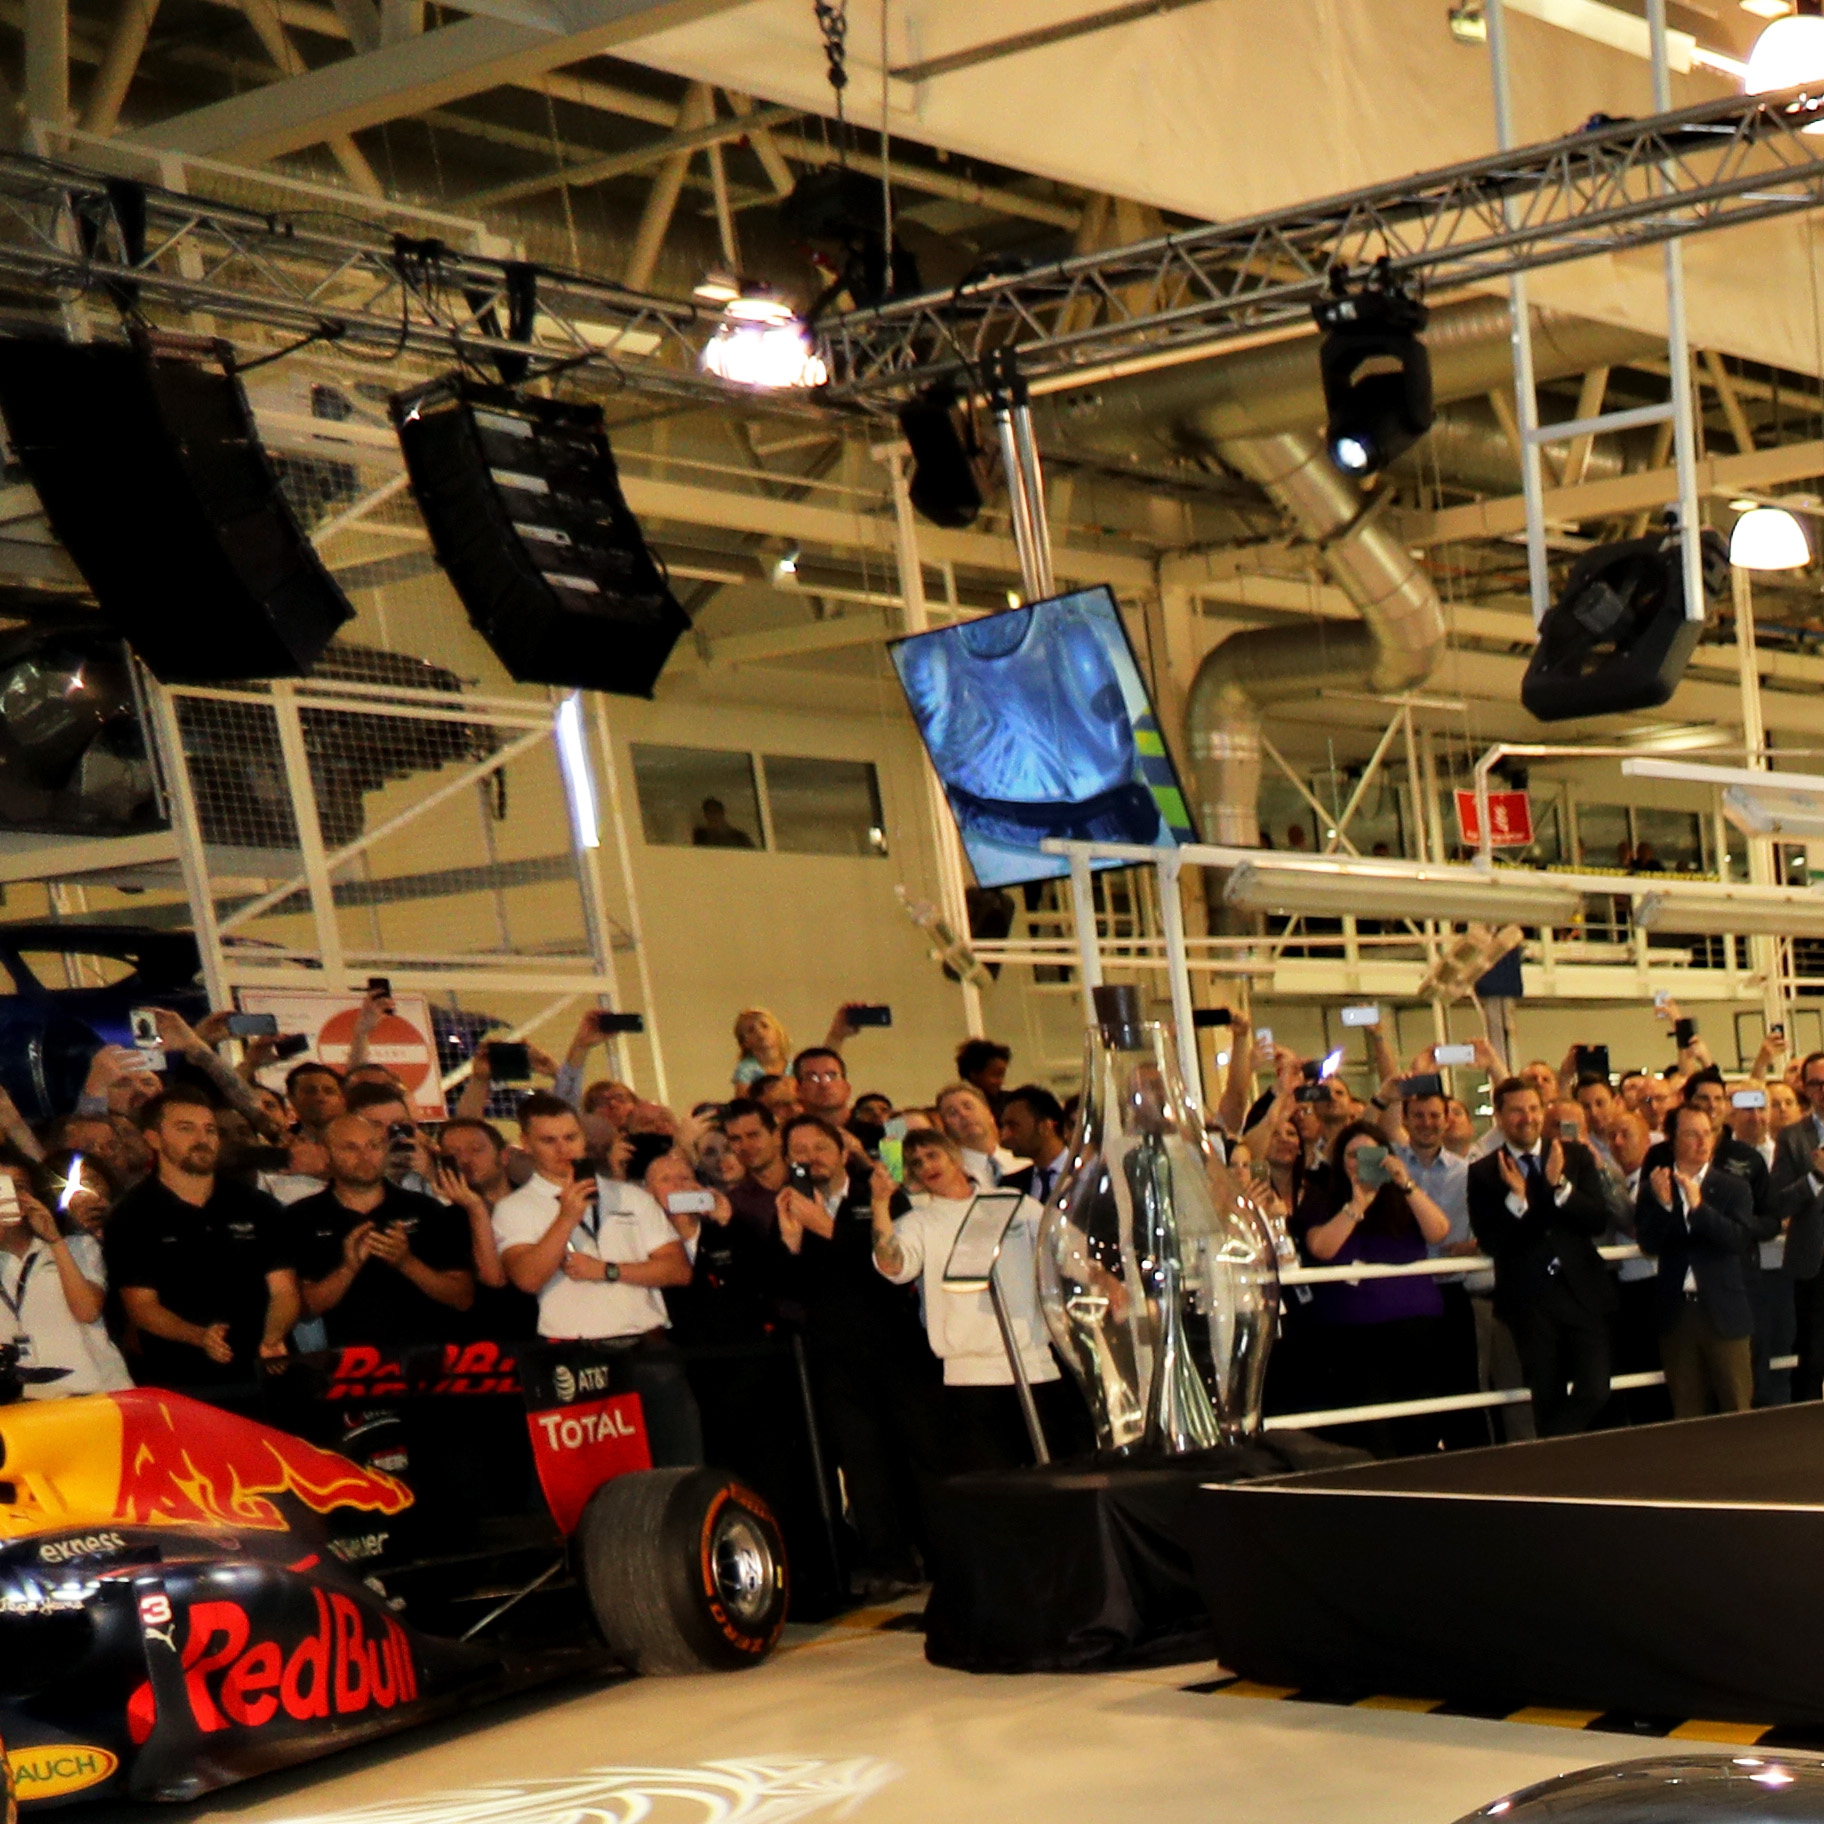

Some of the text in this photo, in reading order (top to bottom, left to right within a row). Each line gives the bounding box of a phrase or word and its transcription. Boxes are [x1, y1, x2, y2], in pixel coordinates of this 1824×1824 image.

[578, 1366, 609, 1393] AT&T
[538, 1408, 637, 1452] TOTAL
[38, 1531, 127, 1563] exness
[139, 1594, 172, 1625] 3
[14, 1754, 97, 1784] AUCH
